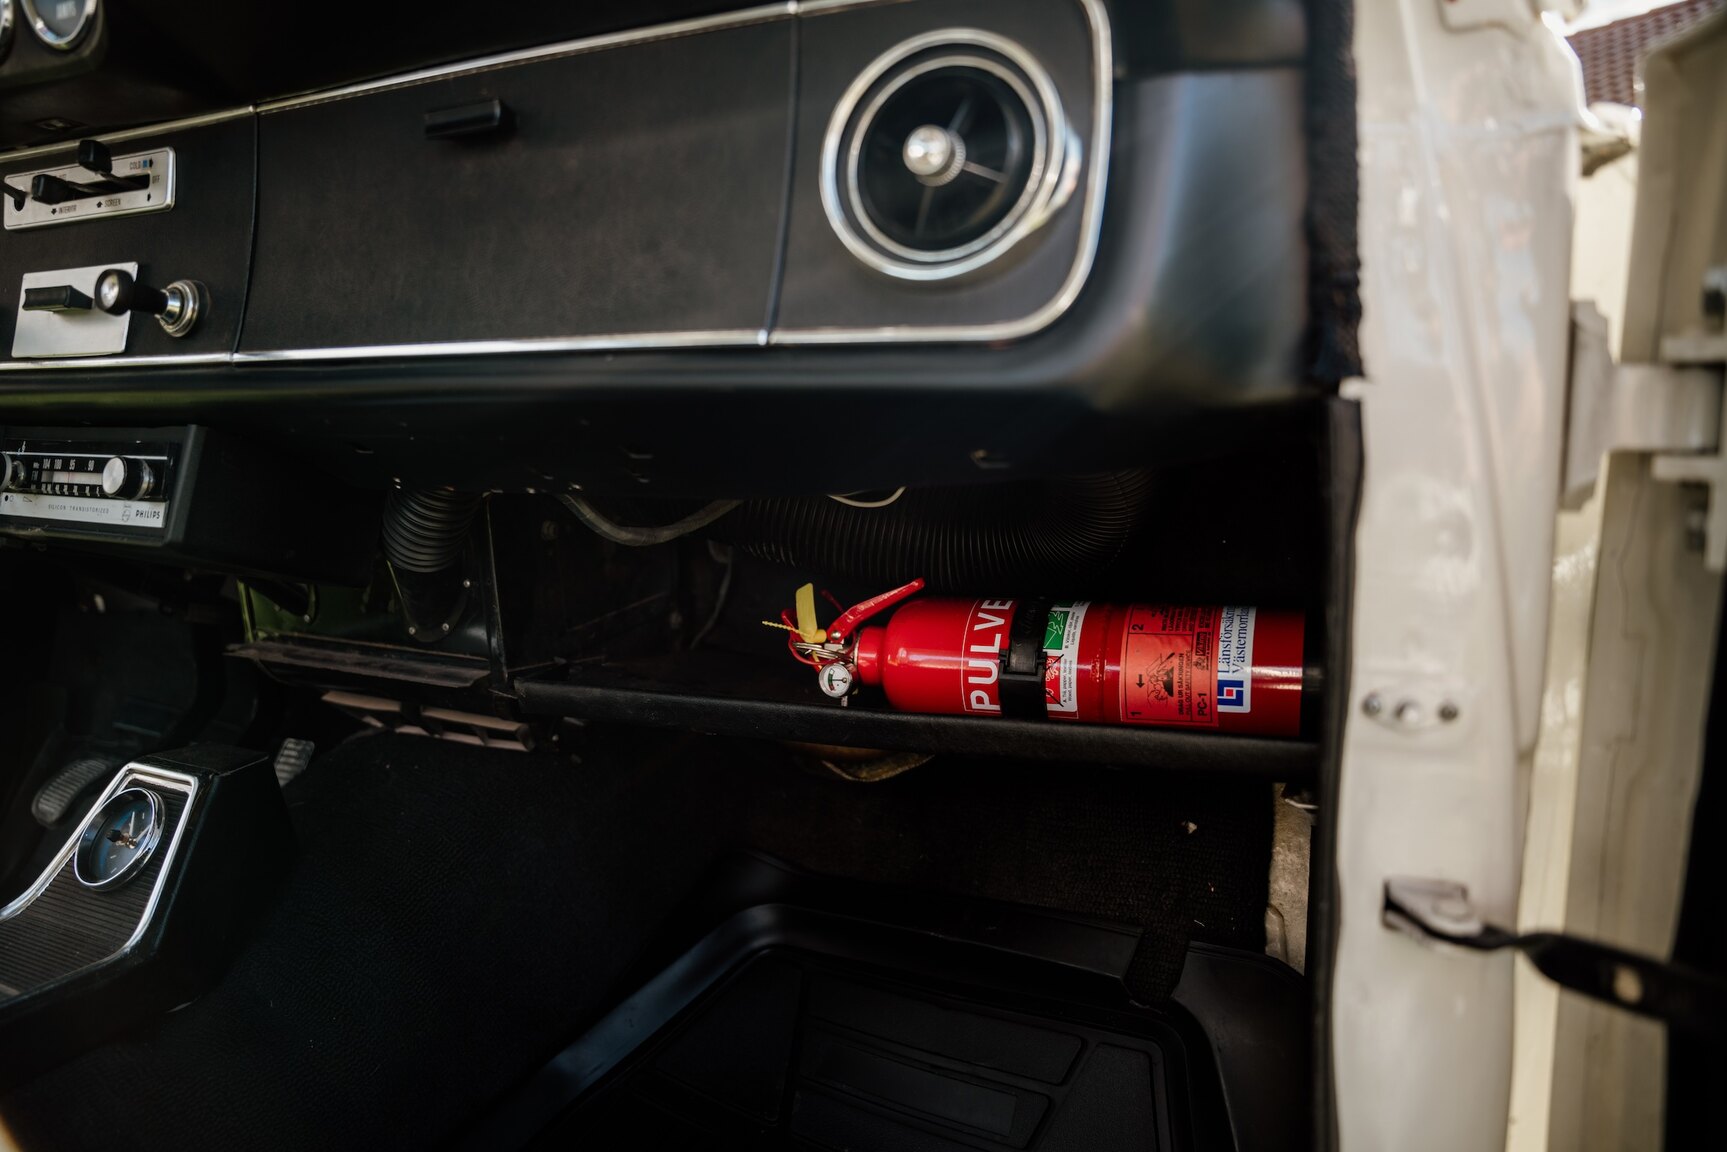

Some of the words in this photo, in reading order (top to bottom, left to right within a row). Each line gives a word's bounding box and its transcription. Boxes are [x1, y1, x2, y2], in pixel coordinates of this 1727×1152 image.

[104, 198, 121, 207] SCREEN
[43, 459, 51, 470] 104
[54, 459, 63, 470] 100
[69, 459, 76, 470] 95
[88, 460, 95, 471] 90
[48, 504, 66, 512] SILICON
[136, 510, 160, 519] PHILIPS
[1178, 690, 1184, 698] UR
[1197, 692, 1207, 716] PC-1
